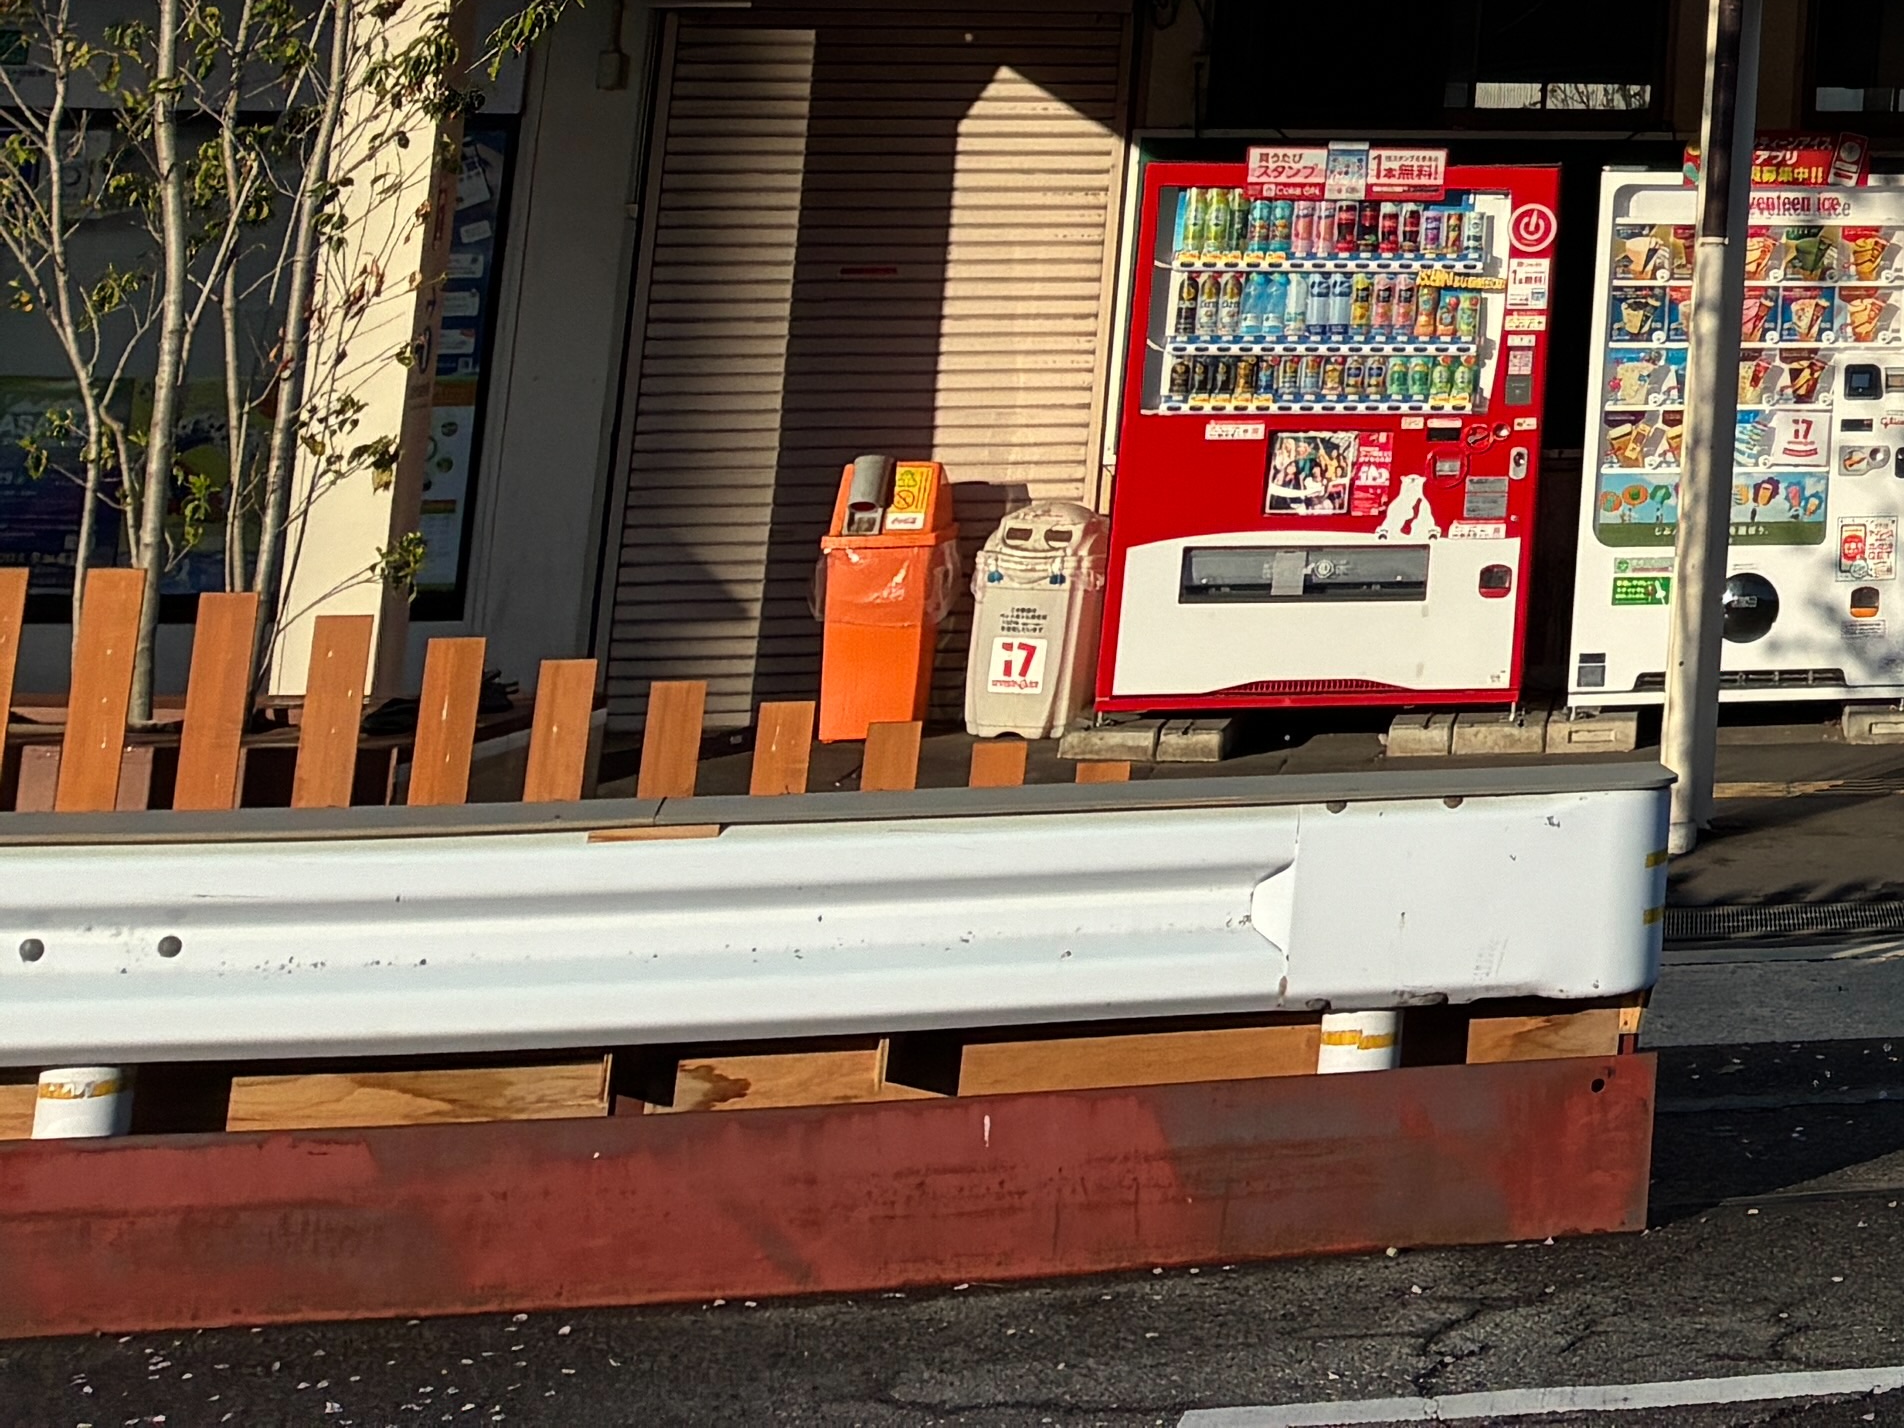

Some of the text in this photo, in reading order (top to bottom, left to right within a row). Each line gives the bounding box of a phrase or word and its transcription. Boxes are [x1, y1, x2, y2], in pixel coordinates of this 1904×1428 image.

[1258, 152, 1304, 164] 買うたび
[1754, 150, 1799, 164] アプリ
[1256, 163, 1319, 179] スタンプ
